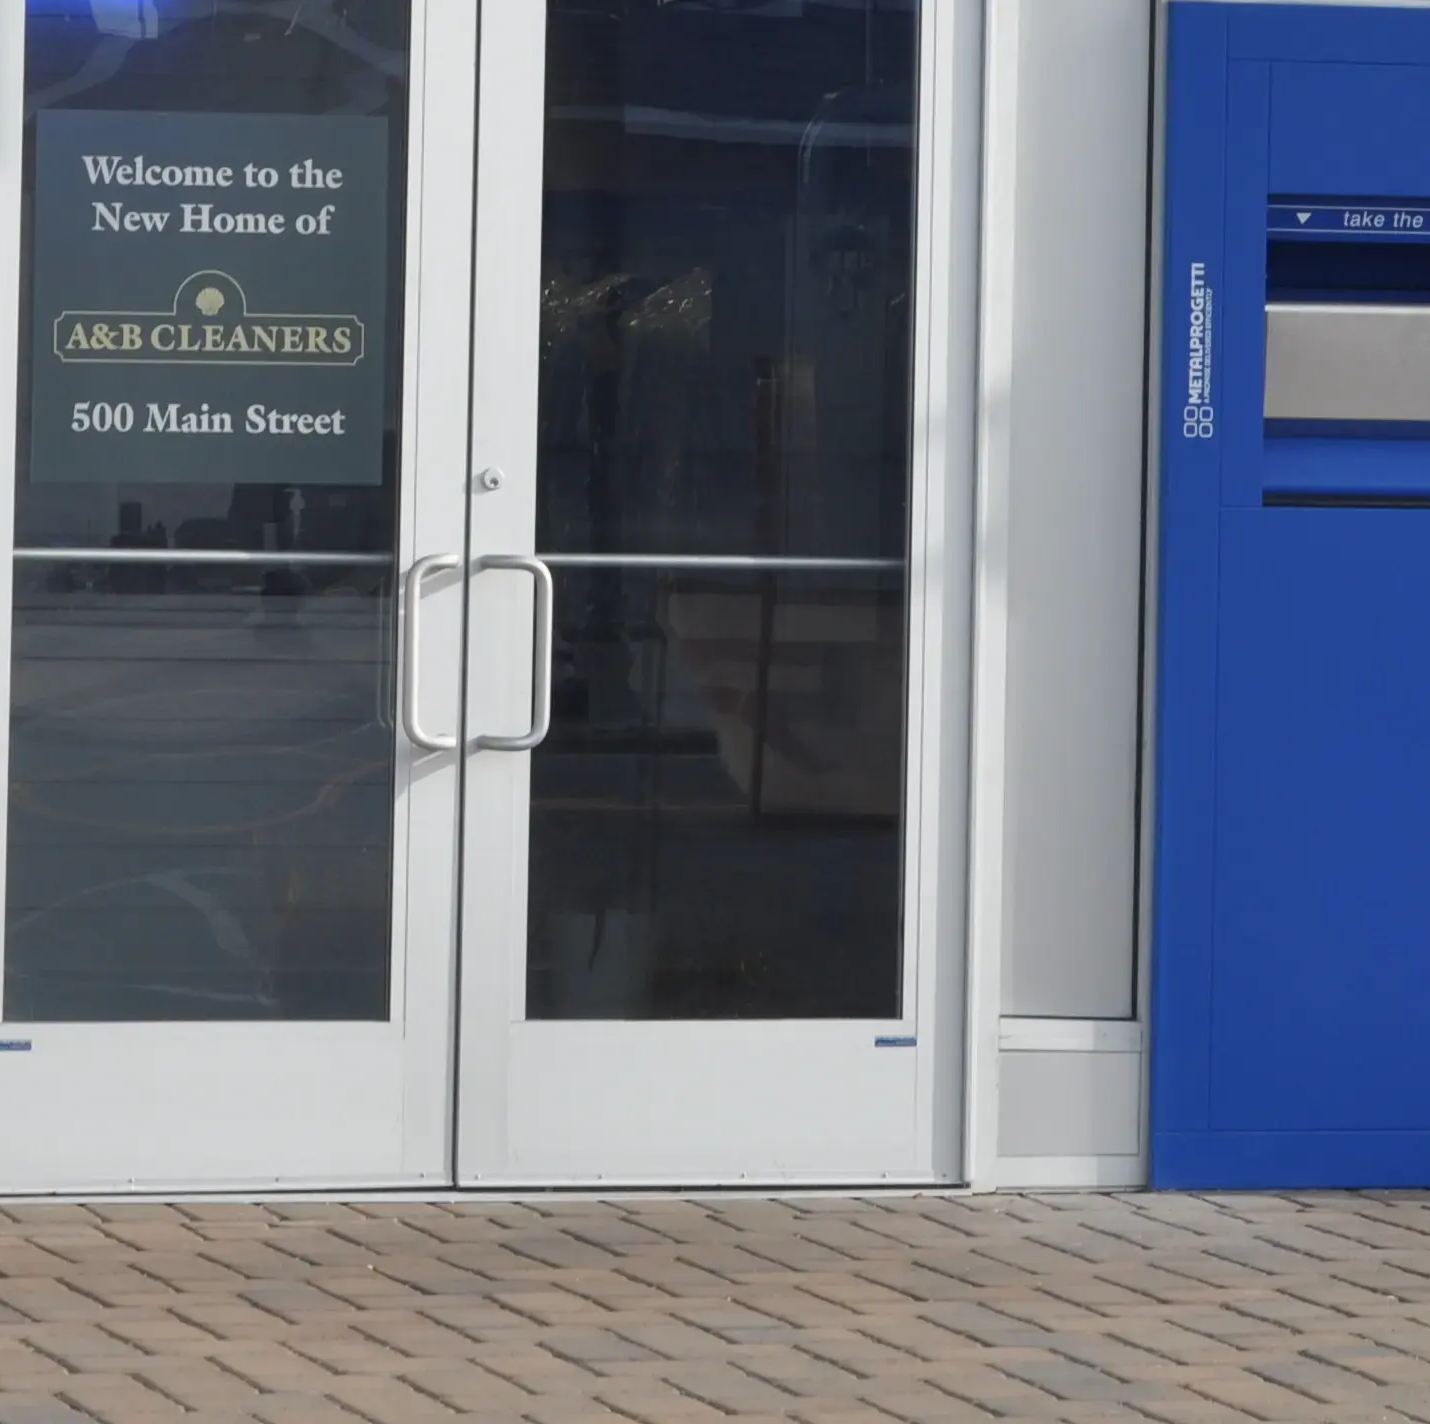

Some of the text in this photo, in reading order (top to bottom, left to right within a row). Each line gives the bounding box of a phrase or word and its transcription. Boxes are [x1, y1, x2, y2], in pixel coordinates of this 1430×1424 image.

[82, 154, 344, 190] Welcome to the
[91, 201, 336, 235] New Home of
[1342, 210, 1386, 229] take
[1392, 211, 1424, 230] the
[65, 323, 352, 354] A&B CLEANERS
[1188, 262, 1205, 405] METALPROGETTI
[71, 401, 346, 435] 500 Main Street
